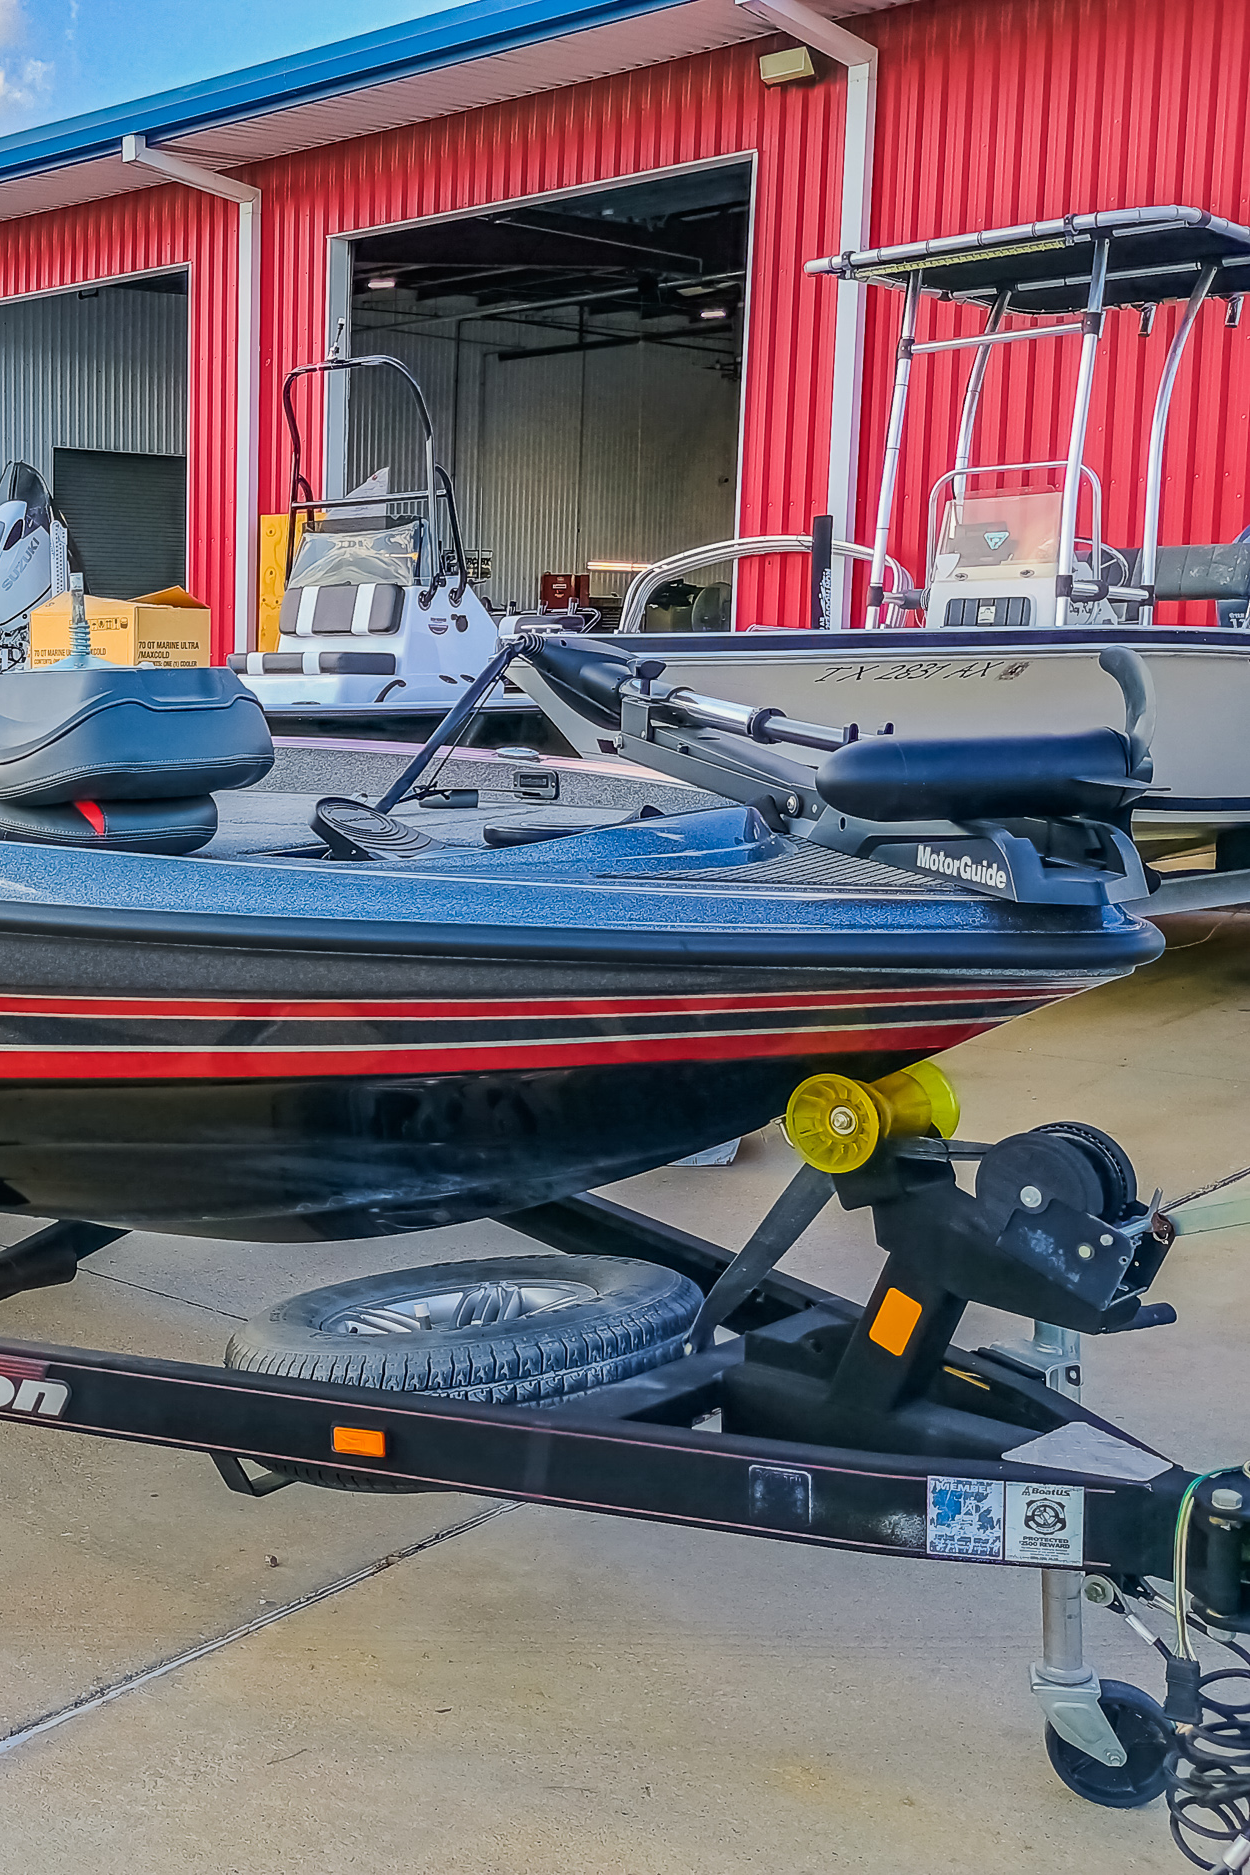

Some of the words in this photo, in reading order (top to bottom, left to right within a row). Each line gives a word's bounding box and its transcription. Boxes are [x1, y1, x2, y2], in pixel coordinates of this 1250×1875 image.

[1, 536, 40, 592] SUZUKI
[138, 641, 146, 649] 70
[147, 641, 155, 650] QT
[156, 641, 180, 650] MARINE
[180, 641, 200, 650] ULTRA
[943, 661, 1004, 679] AX
[916, 844, 1007, 889] MotorGuide
[1022, 1536, 1069, 1544] PROTECTED
[1039, 1541, 1070, 1549] REWARD
